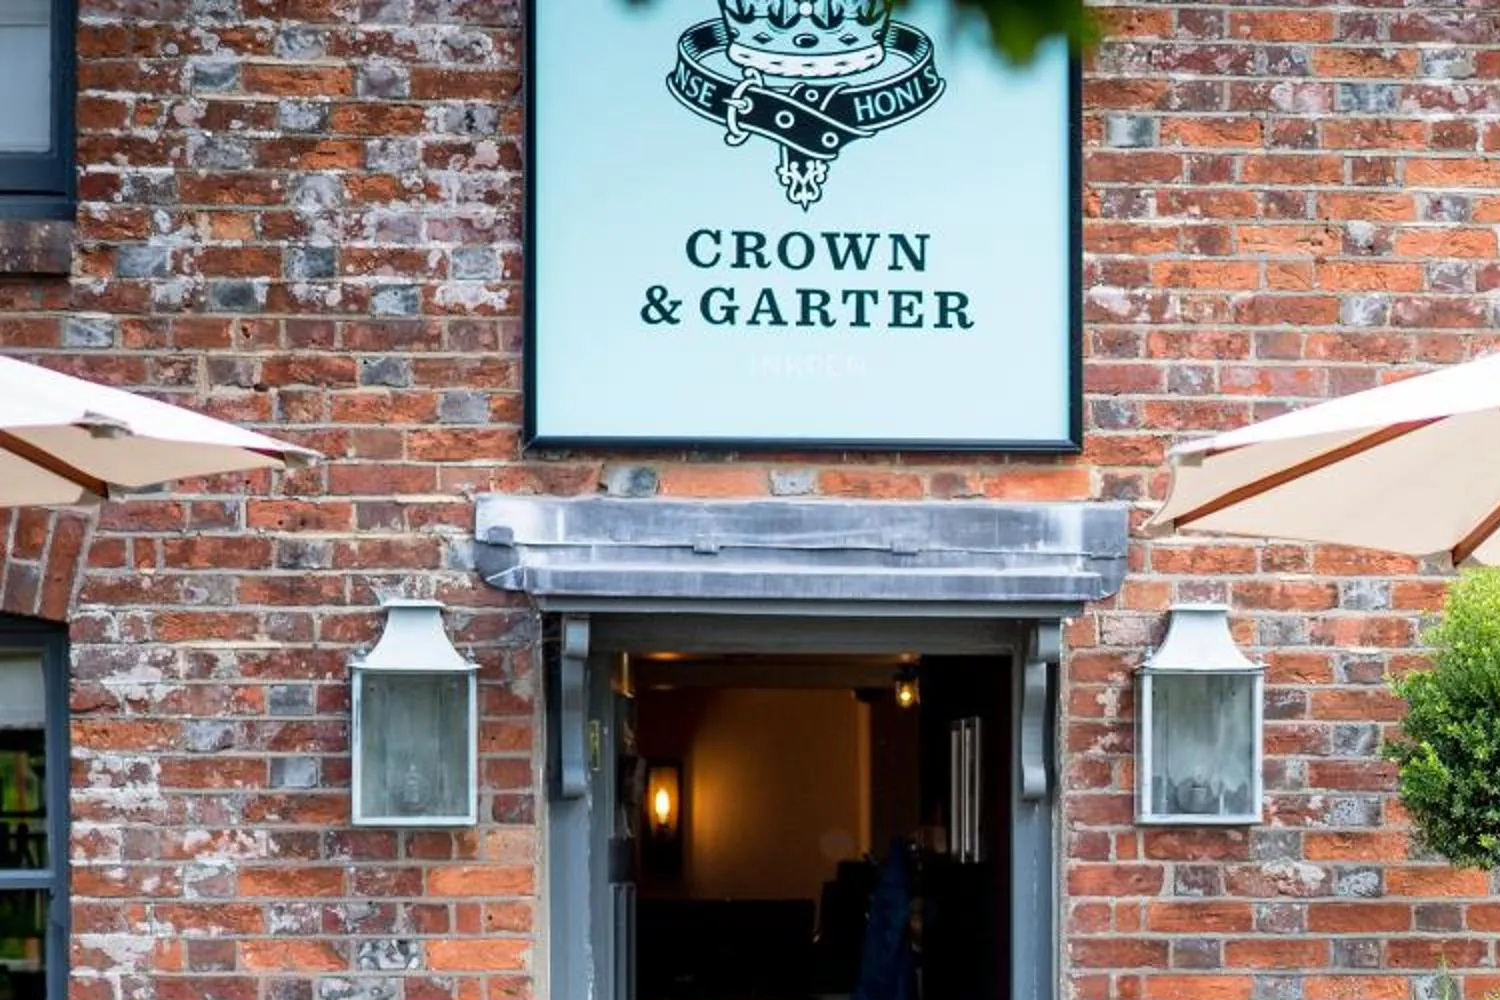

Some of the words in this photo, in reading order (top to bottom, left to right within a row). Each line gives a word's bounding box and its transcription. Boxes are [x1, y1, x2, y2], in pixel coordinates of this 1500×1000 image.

[853, 77, 924, 122] HONI
[685, 229, 931, 272] CROWN
[640, 285, 683, 326] &
[700, 287, 975, 330] GARTER
